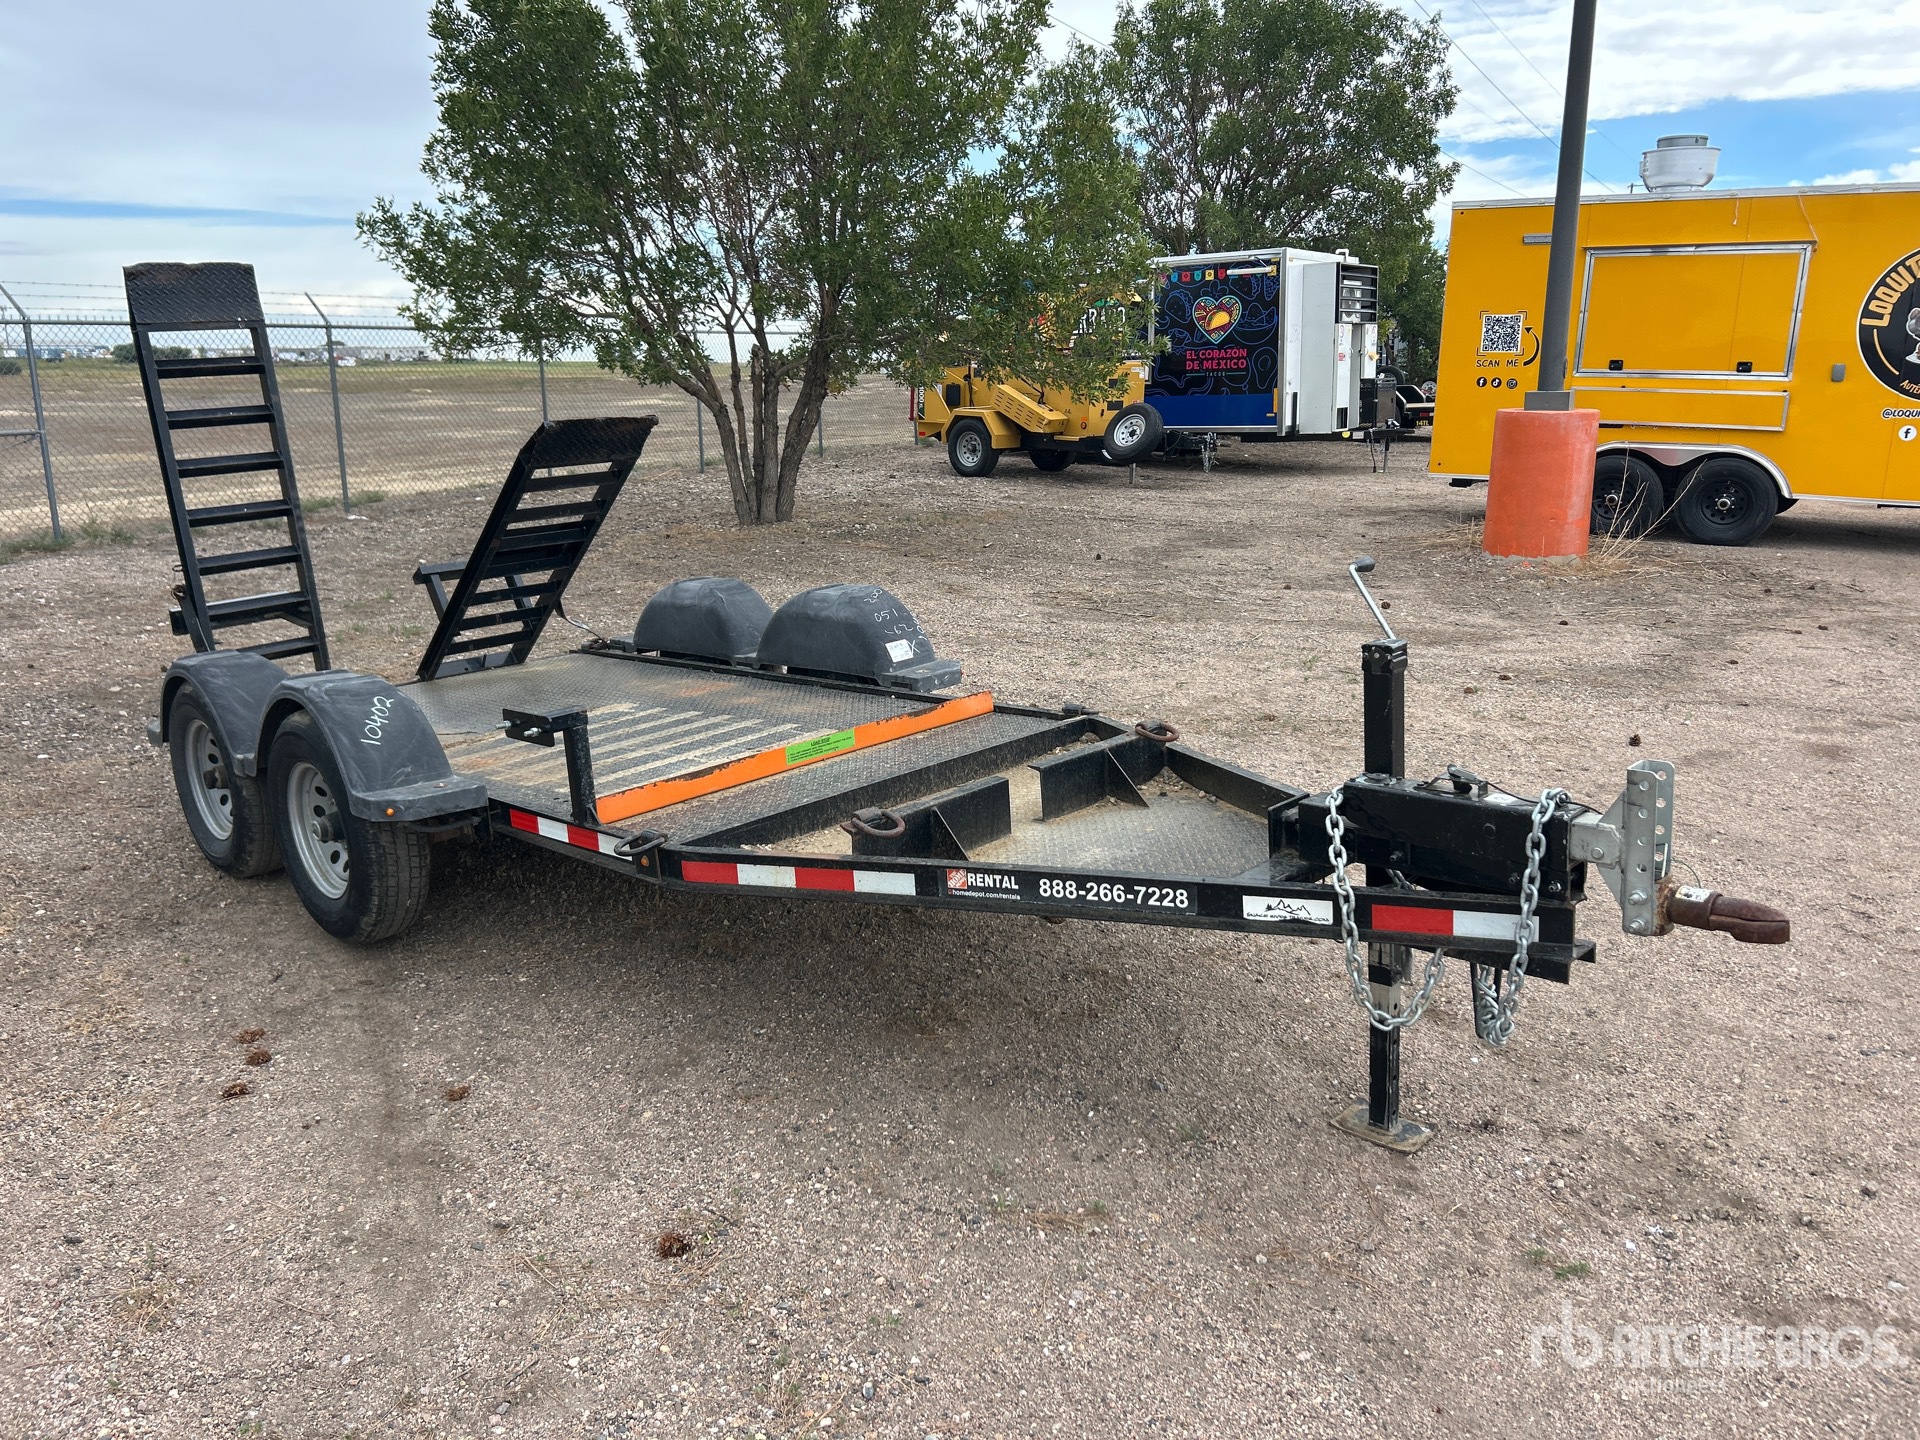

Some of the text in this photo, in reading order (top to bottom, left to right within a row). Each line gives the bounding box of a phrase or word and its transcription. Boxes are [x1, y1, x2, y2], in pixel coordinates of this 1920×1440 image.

[1186, 346, 1247, 359] EL CORAZÓN
[1186, 358, 1247, 370] DE MÉXICO
[1476, 359, 1519, 368] SCAN ME
[360, 696, 394, 745] 10402
[967, 872, 1019, 890] RENTAL
[952, 889, 1021, 900] homedepot.com/rentals
[1039, 878, 1189, 908] 888-266-7228
